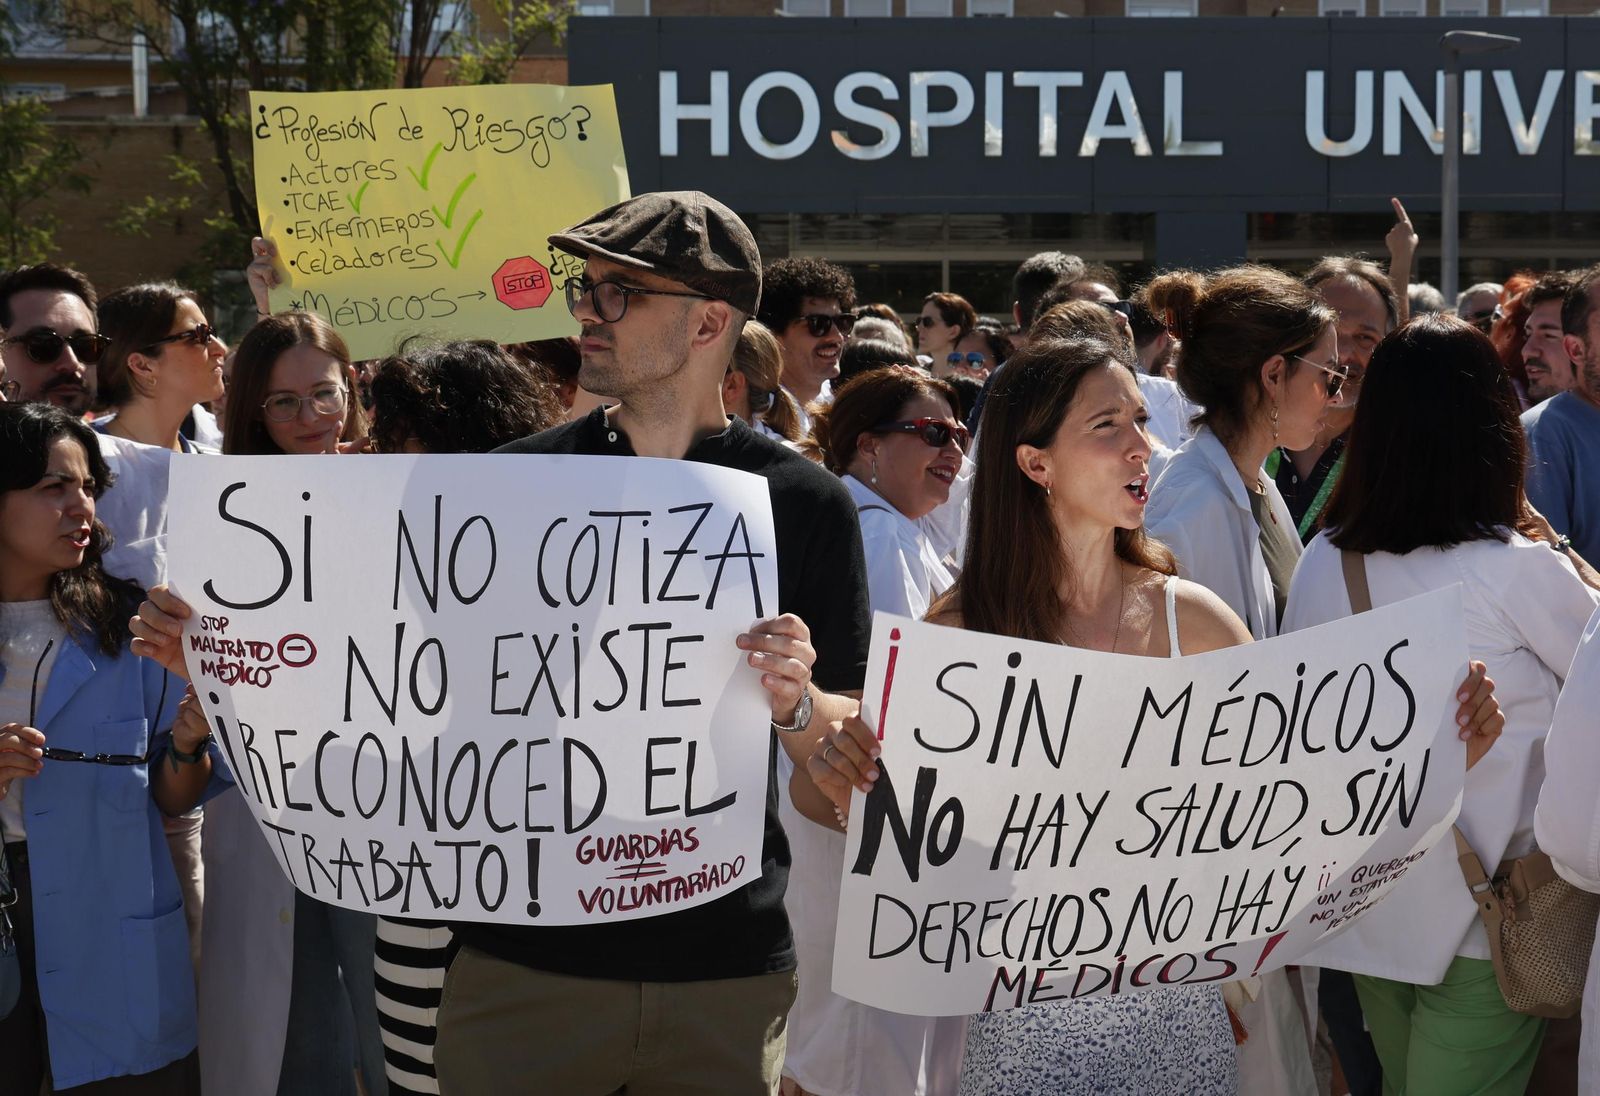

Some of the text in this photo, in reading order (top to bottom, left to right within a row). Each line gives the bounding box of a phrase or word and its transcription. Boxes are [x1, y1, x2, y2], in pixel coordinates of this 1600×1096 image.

[399, 106, 423, 141] de
[659, 70, 1223, 160] HOSPITAL
[291, 191, 345, 214] TCAE
[507, 275, 543, 291] STOP
[393, 494, 497, 613] NO
[190, 635, 274, 662] MALTRATO
[200, 615, 229, 634] STOP
[344, 622, 448, 726] NO
[208, 691, 738, 834] ¡RECONOCED EL
[990, 790, 1110, 871] HAY
[1115, 779, 1309, 858] SALUD,
[262, 819, 541, 918] TRABAJO!
[1317, 890, 1341, 906] UN
[869, 887, 1113, 973] DERECHOS
[1114, 877, 1194, 957] NO
[1205, 864, 1306, 942] HAY
[1309, 909, 1334, 924] NO
[1342, 895, 1368, 912] UN
